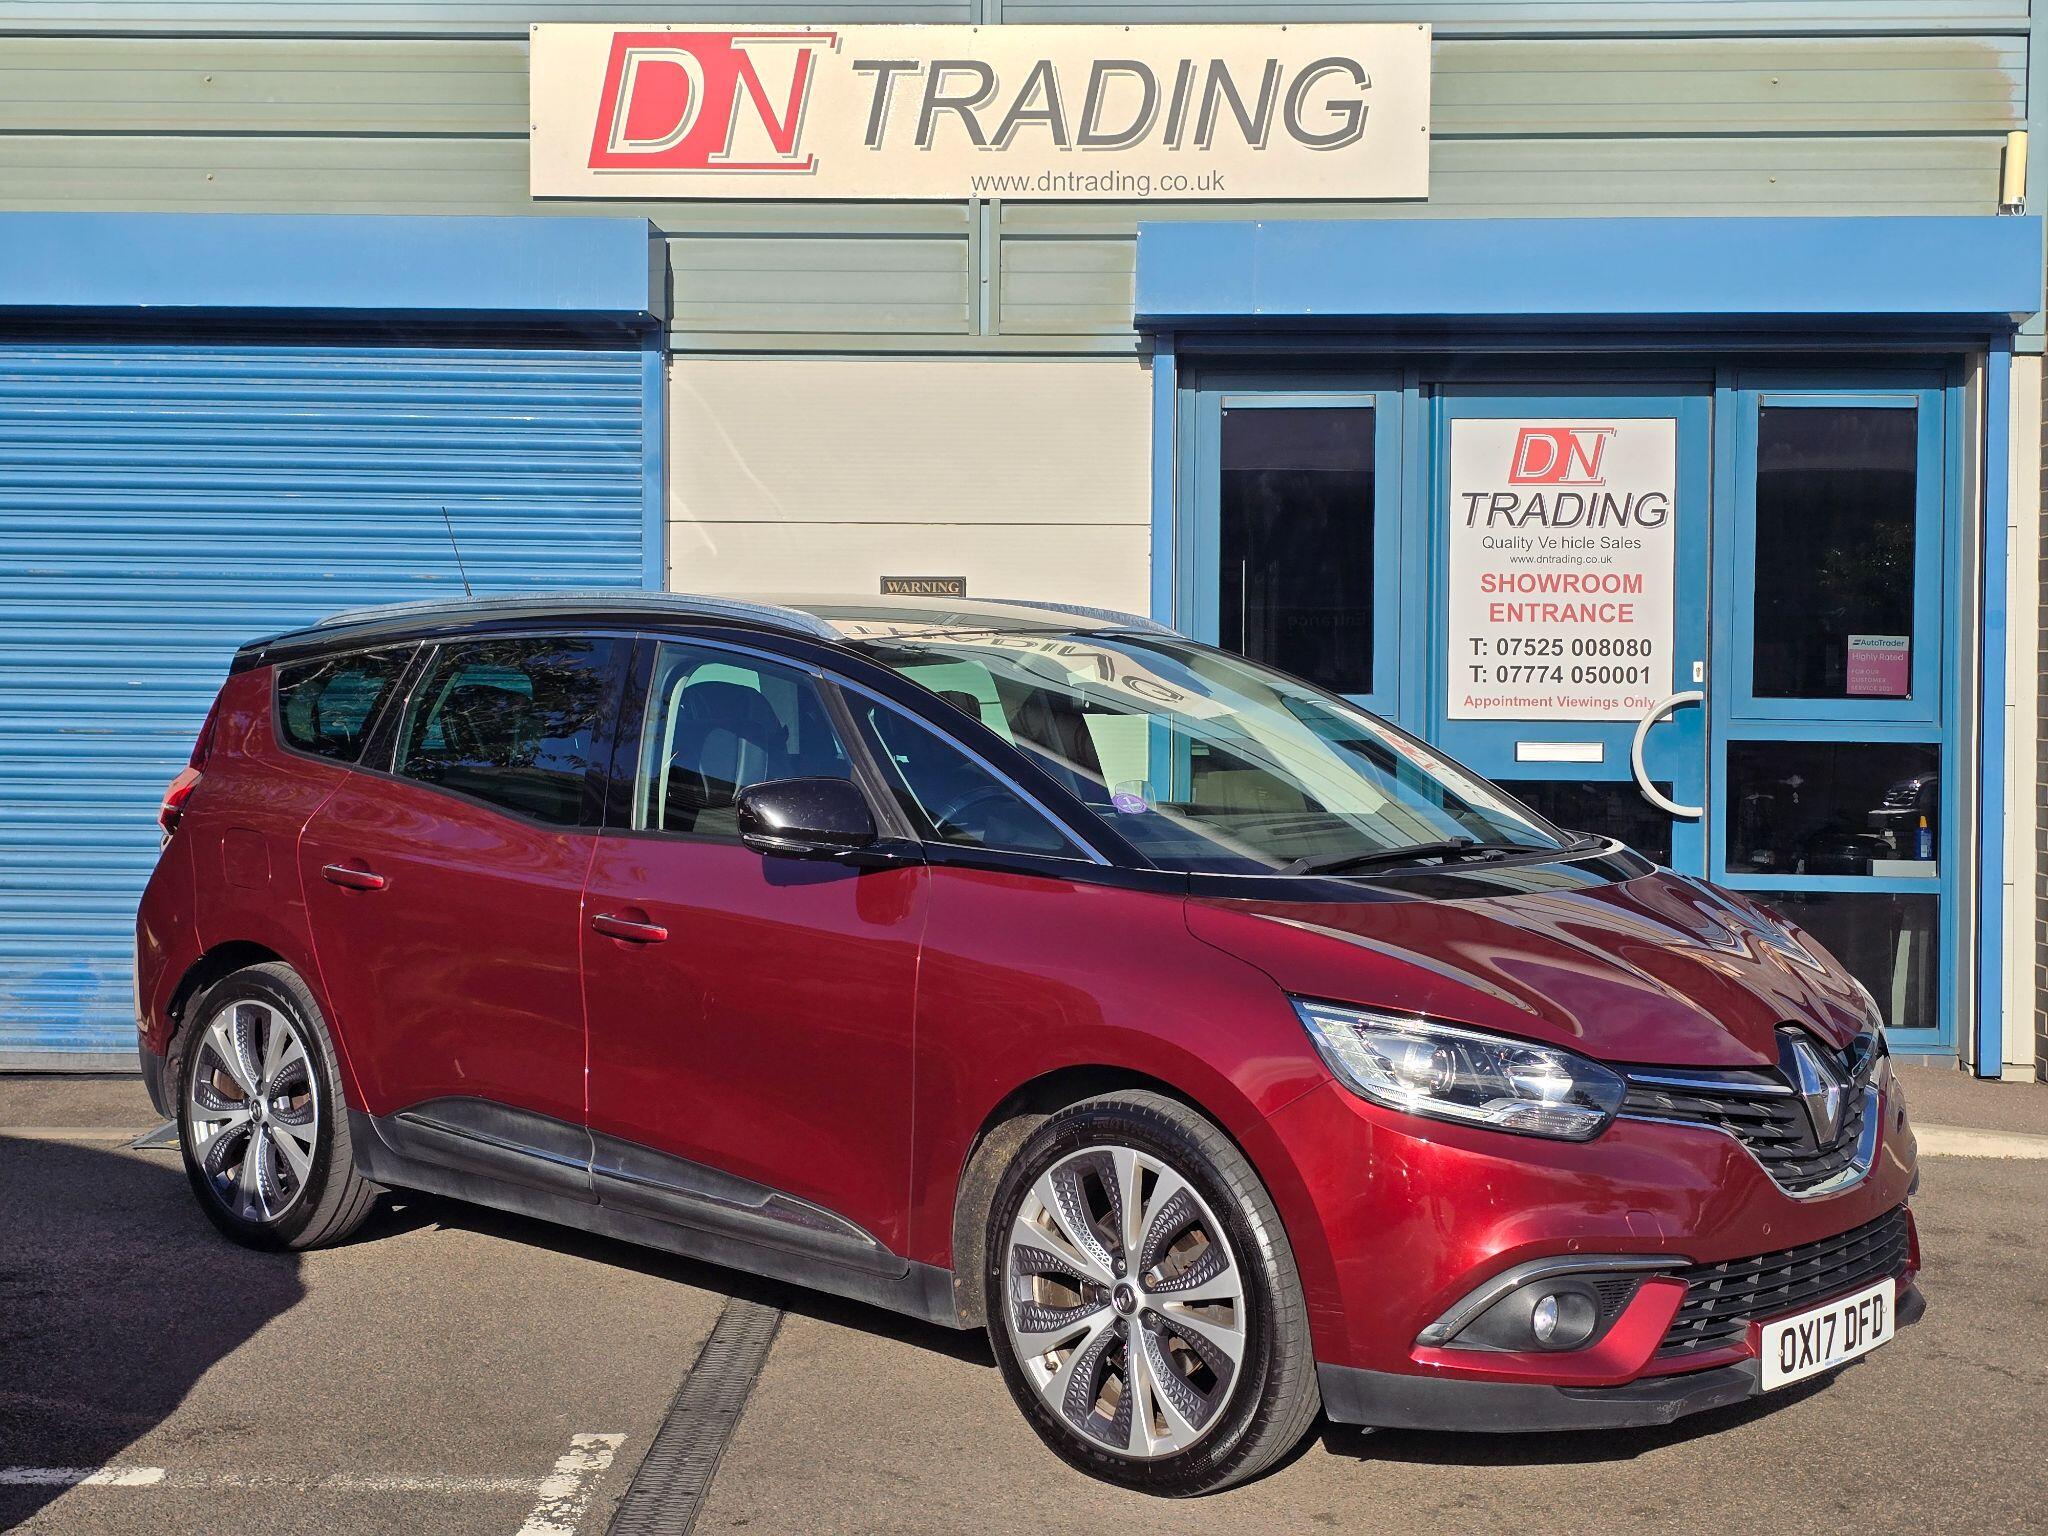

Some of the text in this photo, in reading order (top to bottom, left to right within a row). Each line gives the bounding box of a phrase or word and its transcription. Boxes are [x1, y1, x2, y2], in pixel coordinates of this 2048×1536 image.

[604, 36, 1370, 166] DN TRADING
[971, 171, 1225, 197] www.dntrading.co.uk
[1516, 427, 1617, 482] DN
[1461, 492, 1670, 529] TRADING
[1482, 536, 1533, 551] Quality
[1600, 537, 1641, 549] Sales
[1510, 554, 1612, 565] www.dntrading.co.uk
[887, 581, 960, 592] WARNING
[1480, 573, 1642, 594] SHOWROOM
[1489, 603, 1634, 623] ENTRANCE
[1469, 638, 1651, 657] T: 07525 008080
[1860, 639, 1904, 647] AutoTrader
[1852, 653, 1878, 662] Highly
[1469, 665, 1650, 684] T: 07774 050001
[1464, 695, 1655, 710] Appointment Viewings Only
[1781, 1294, 1883, 1374] OX17 DFD
